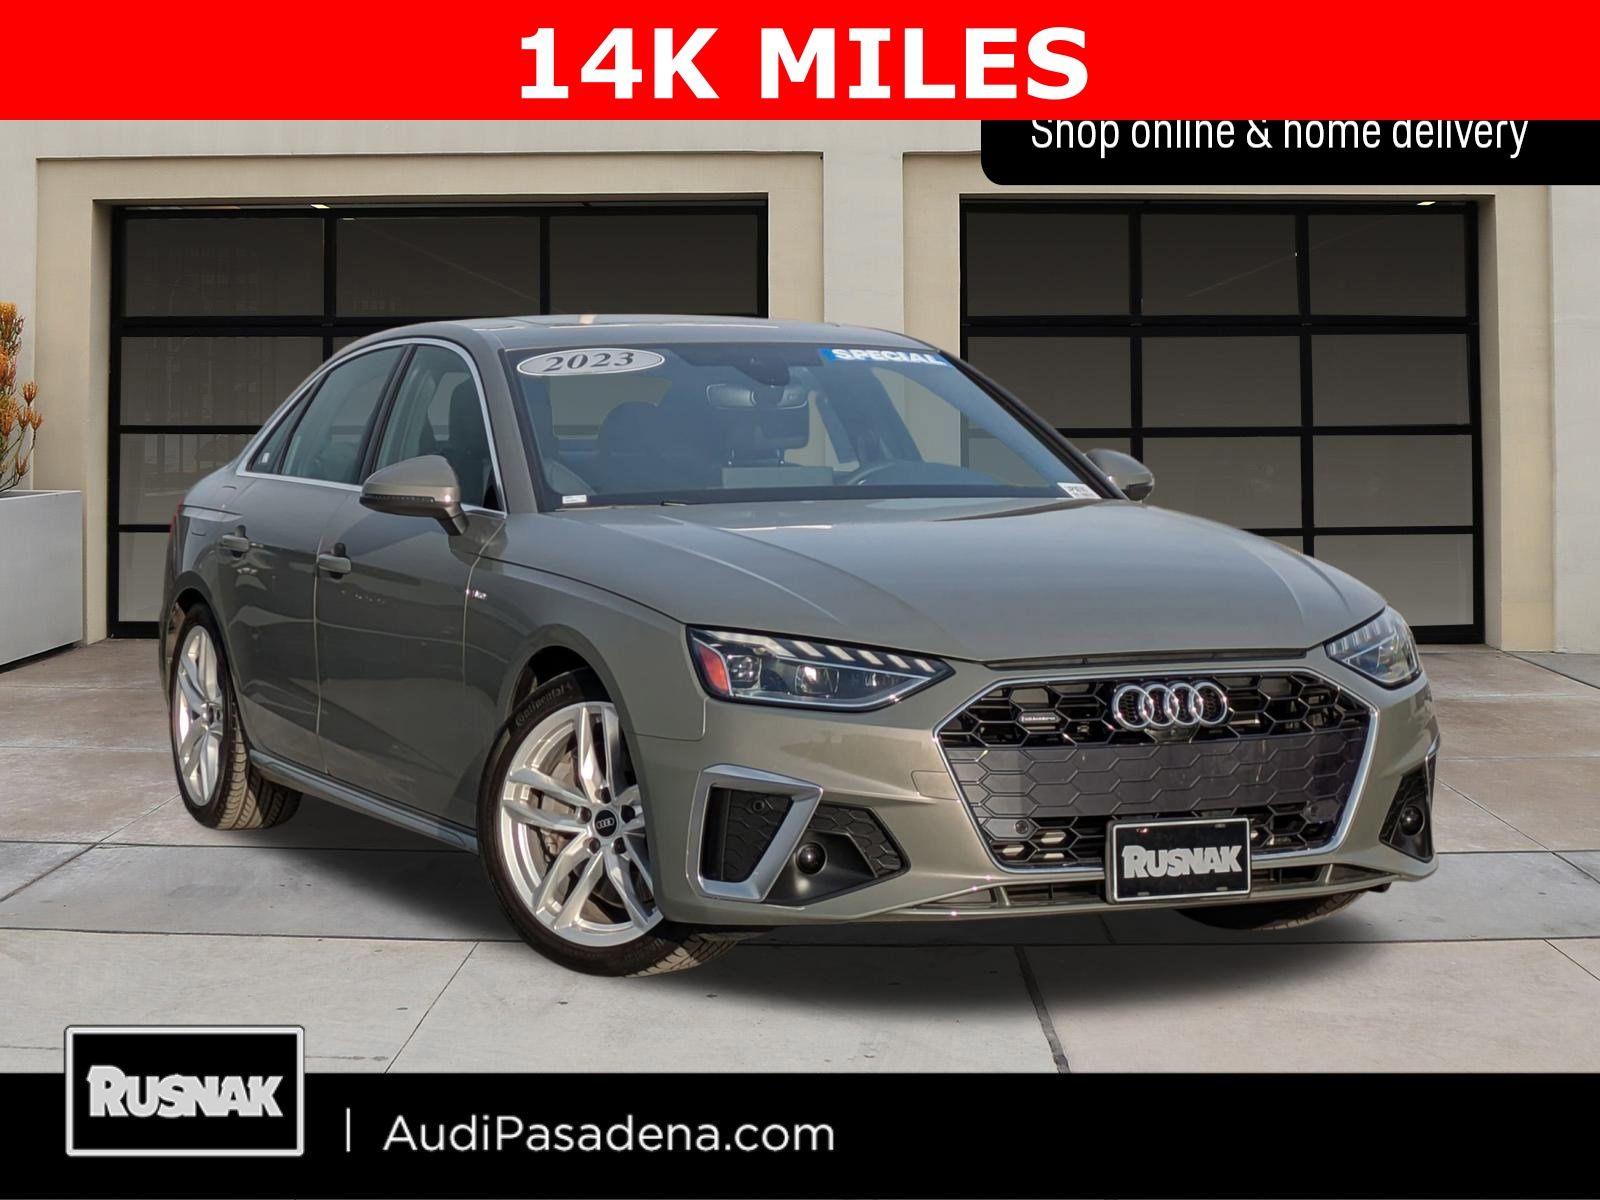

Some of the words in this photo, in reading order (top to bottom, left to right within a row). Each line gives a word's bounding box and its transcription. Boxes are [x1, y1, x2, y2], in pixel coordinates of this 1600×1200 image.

[543, 352, 634, 372] 2023
[831, 348, 949, 367] SPECIAL
[1121, 845, 1243, 879] RUSNAK
